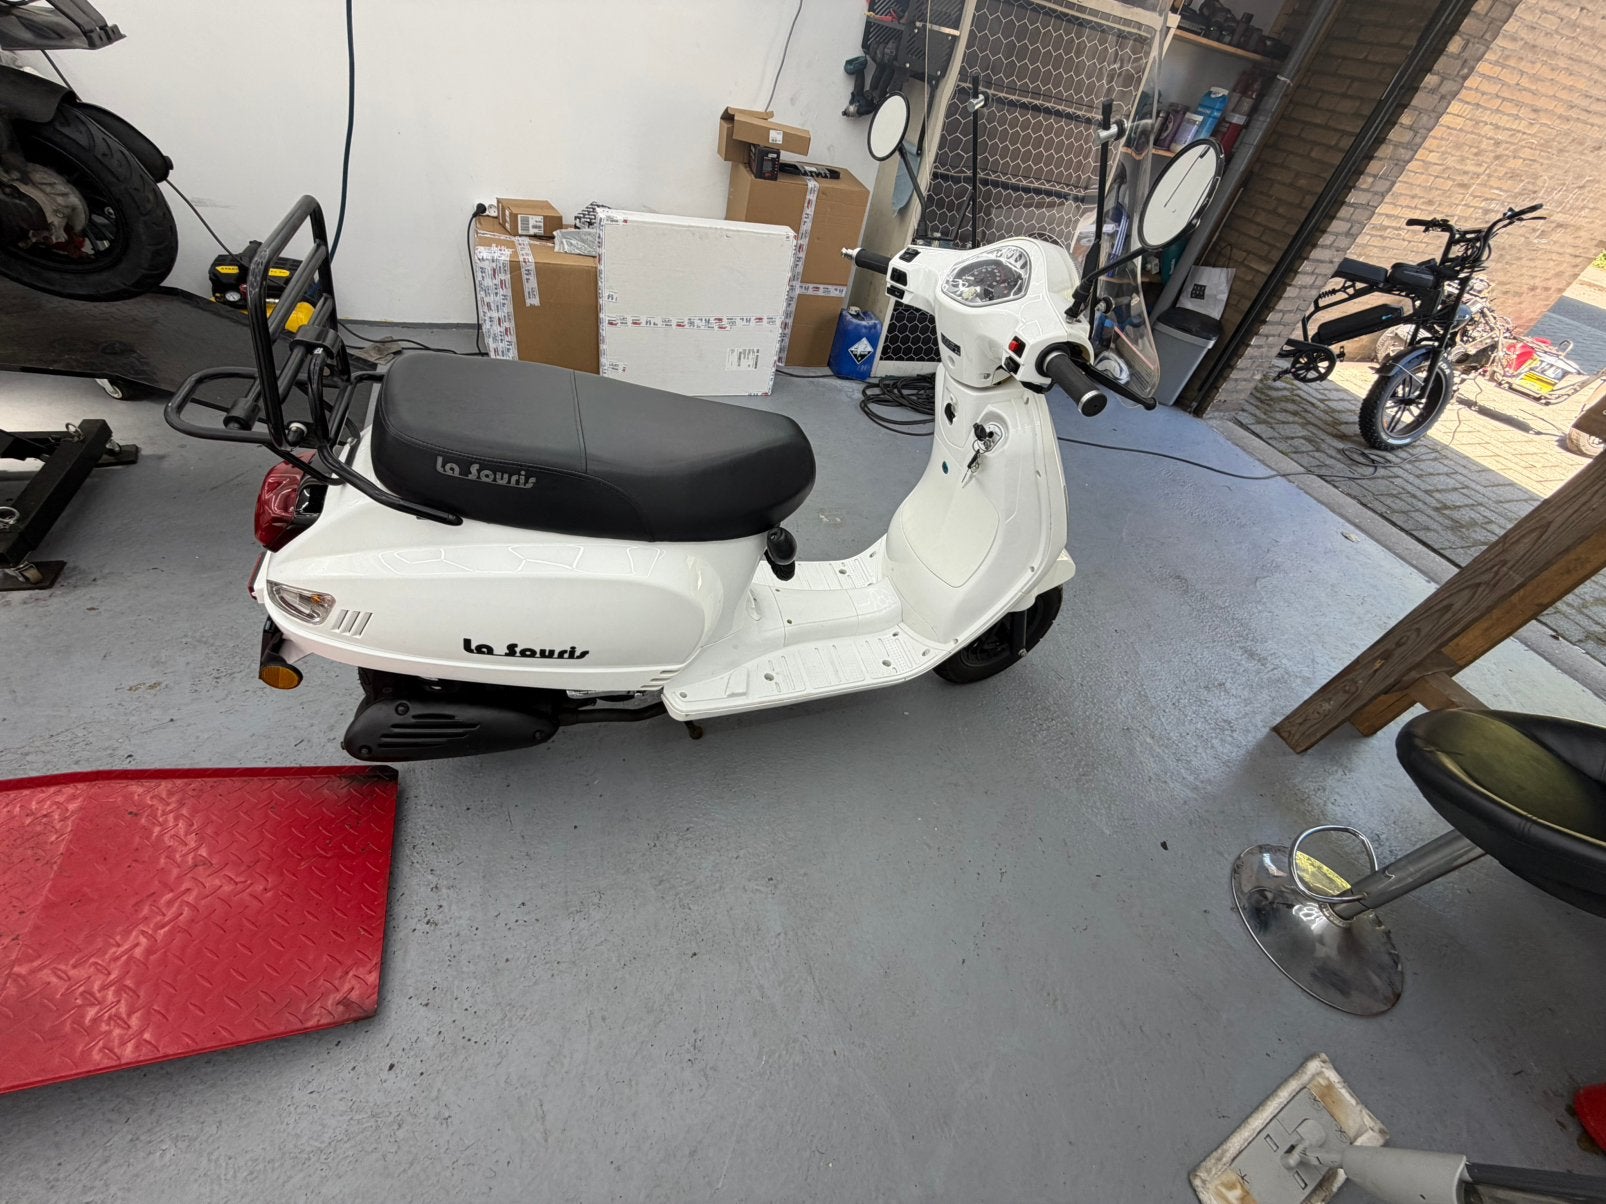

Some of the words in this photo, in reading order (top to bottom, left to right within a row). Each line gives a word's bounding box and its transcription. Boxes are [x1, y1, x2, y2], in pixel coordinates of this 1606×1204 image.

[436, 455, 460, 476] La
[468, 463, 536, 488] Souris
[463, 637, 494, 655] La
[505, 643, 590, 660] Souris
